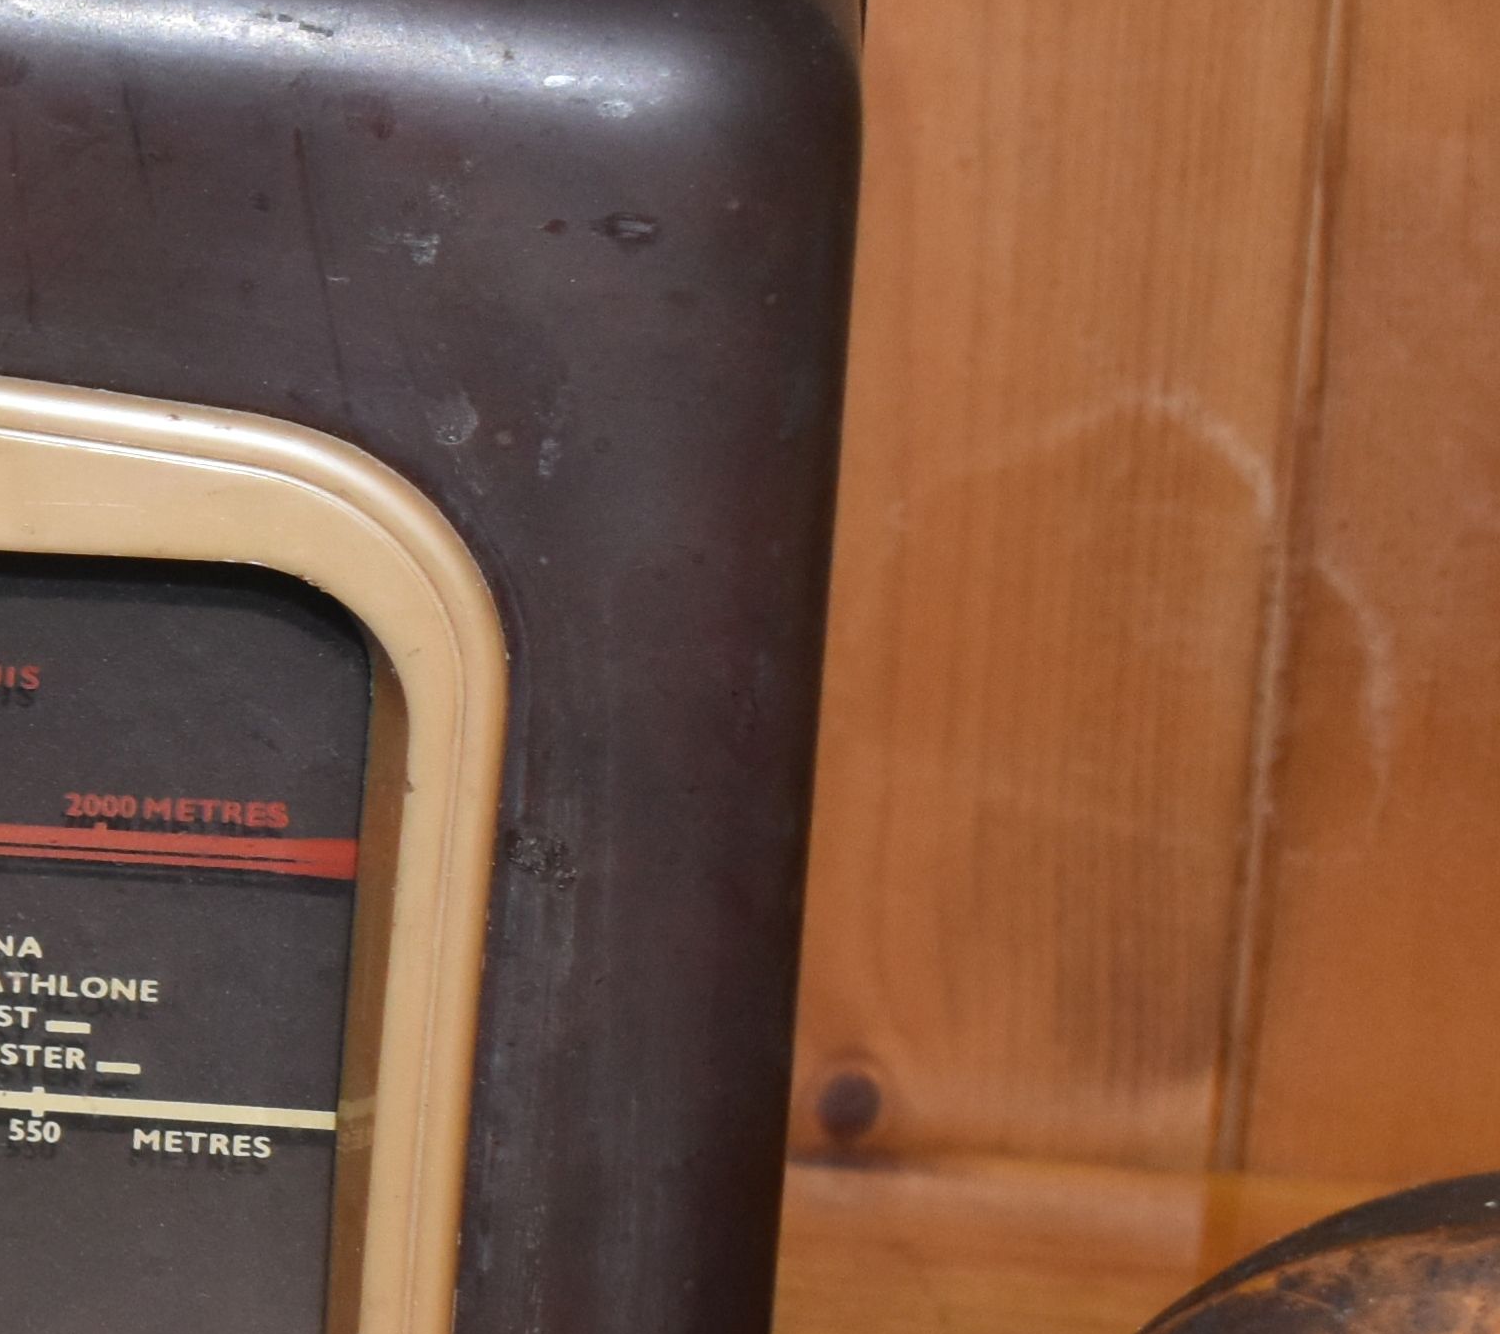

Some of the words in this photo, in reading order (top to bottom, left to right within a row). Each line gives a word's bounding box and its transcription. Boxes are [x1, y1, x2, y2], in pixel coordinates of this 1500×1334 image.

[65, 792, 136, 818] 2000
[142, 796, 288, 828] METRES
[7, 1117, 62, 1144] 550
[131, 1128, 272, 1160] METRES
